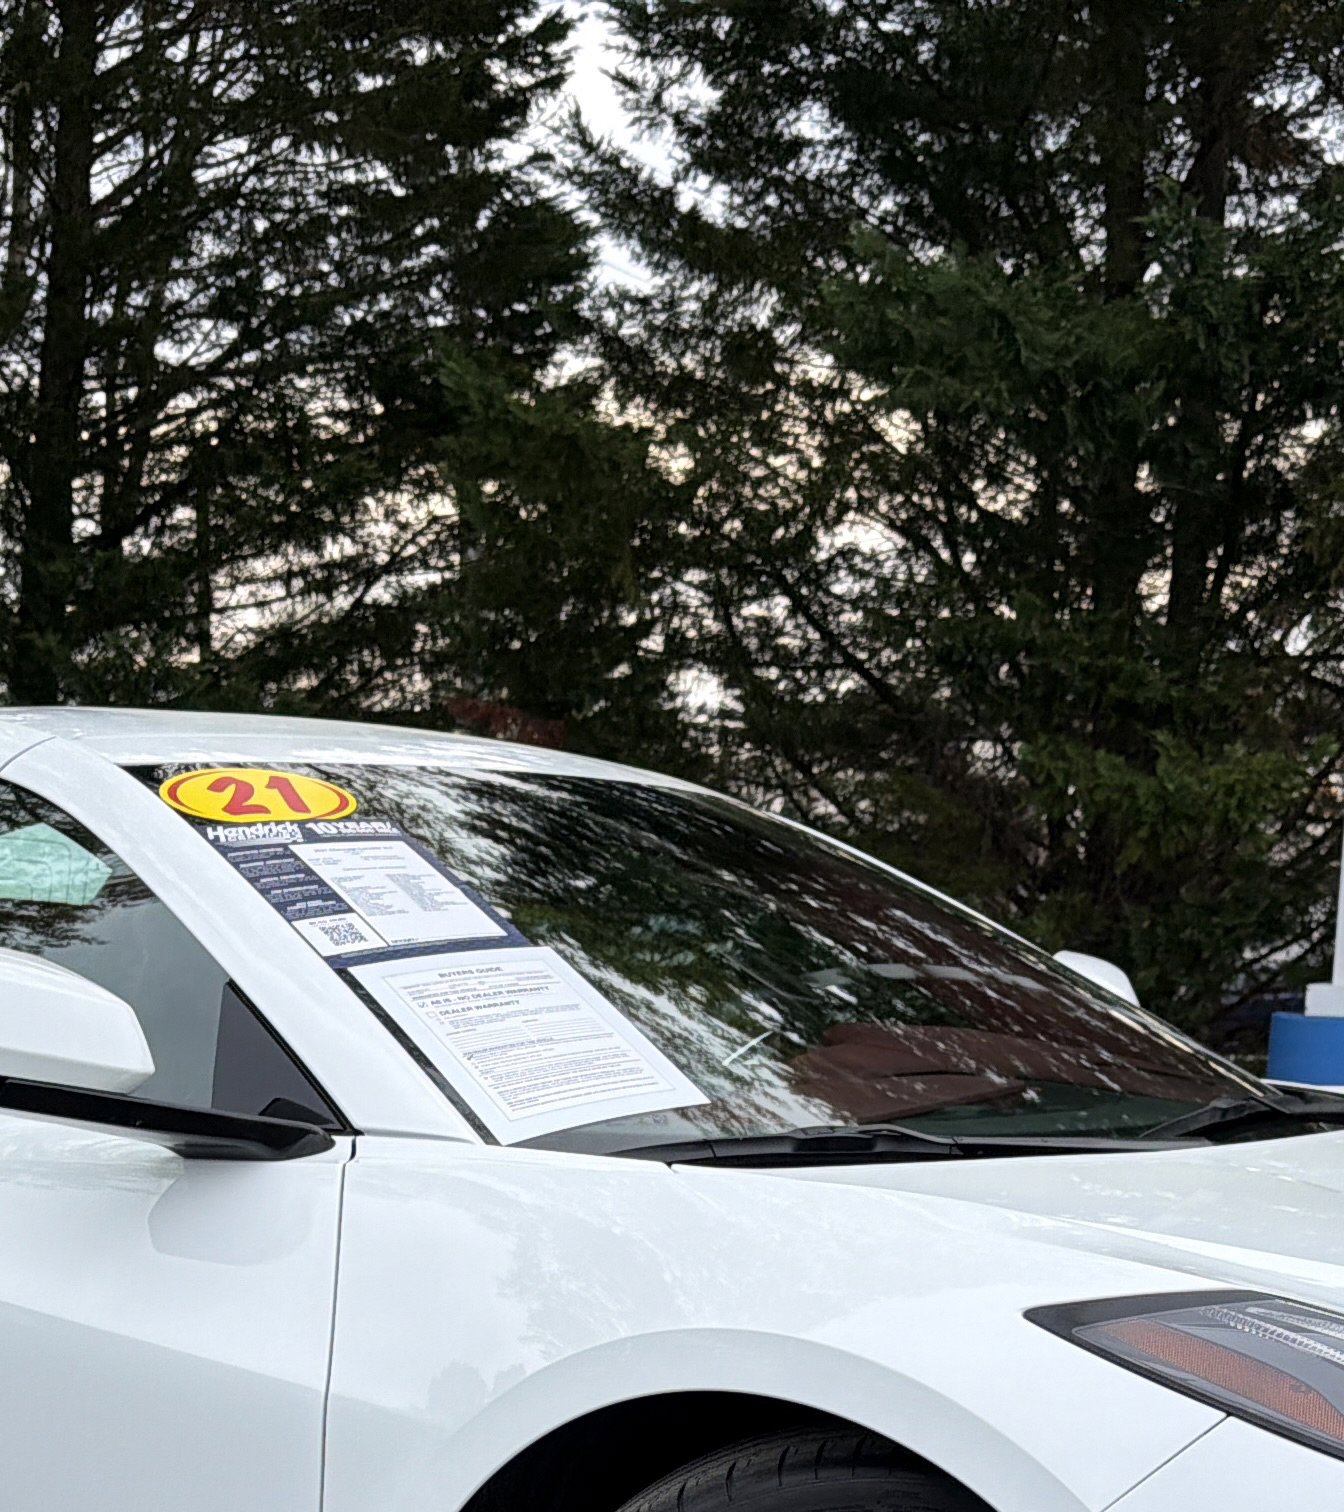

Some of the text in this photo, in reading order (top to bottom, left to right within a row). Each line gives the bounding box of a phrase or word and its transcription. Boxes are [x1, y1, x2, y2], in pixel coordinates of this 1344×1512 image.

[206, 776, 312, 816] 21
[206, 821, 299, 843] Hendrick
[304, 821, 339, 835] 10
[471, 990, 505, 999] DEALER
[505, 986, 550, 995] WARRANTY
[439, 1000, 520, 1016] DEALER WARRANTY
